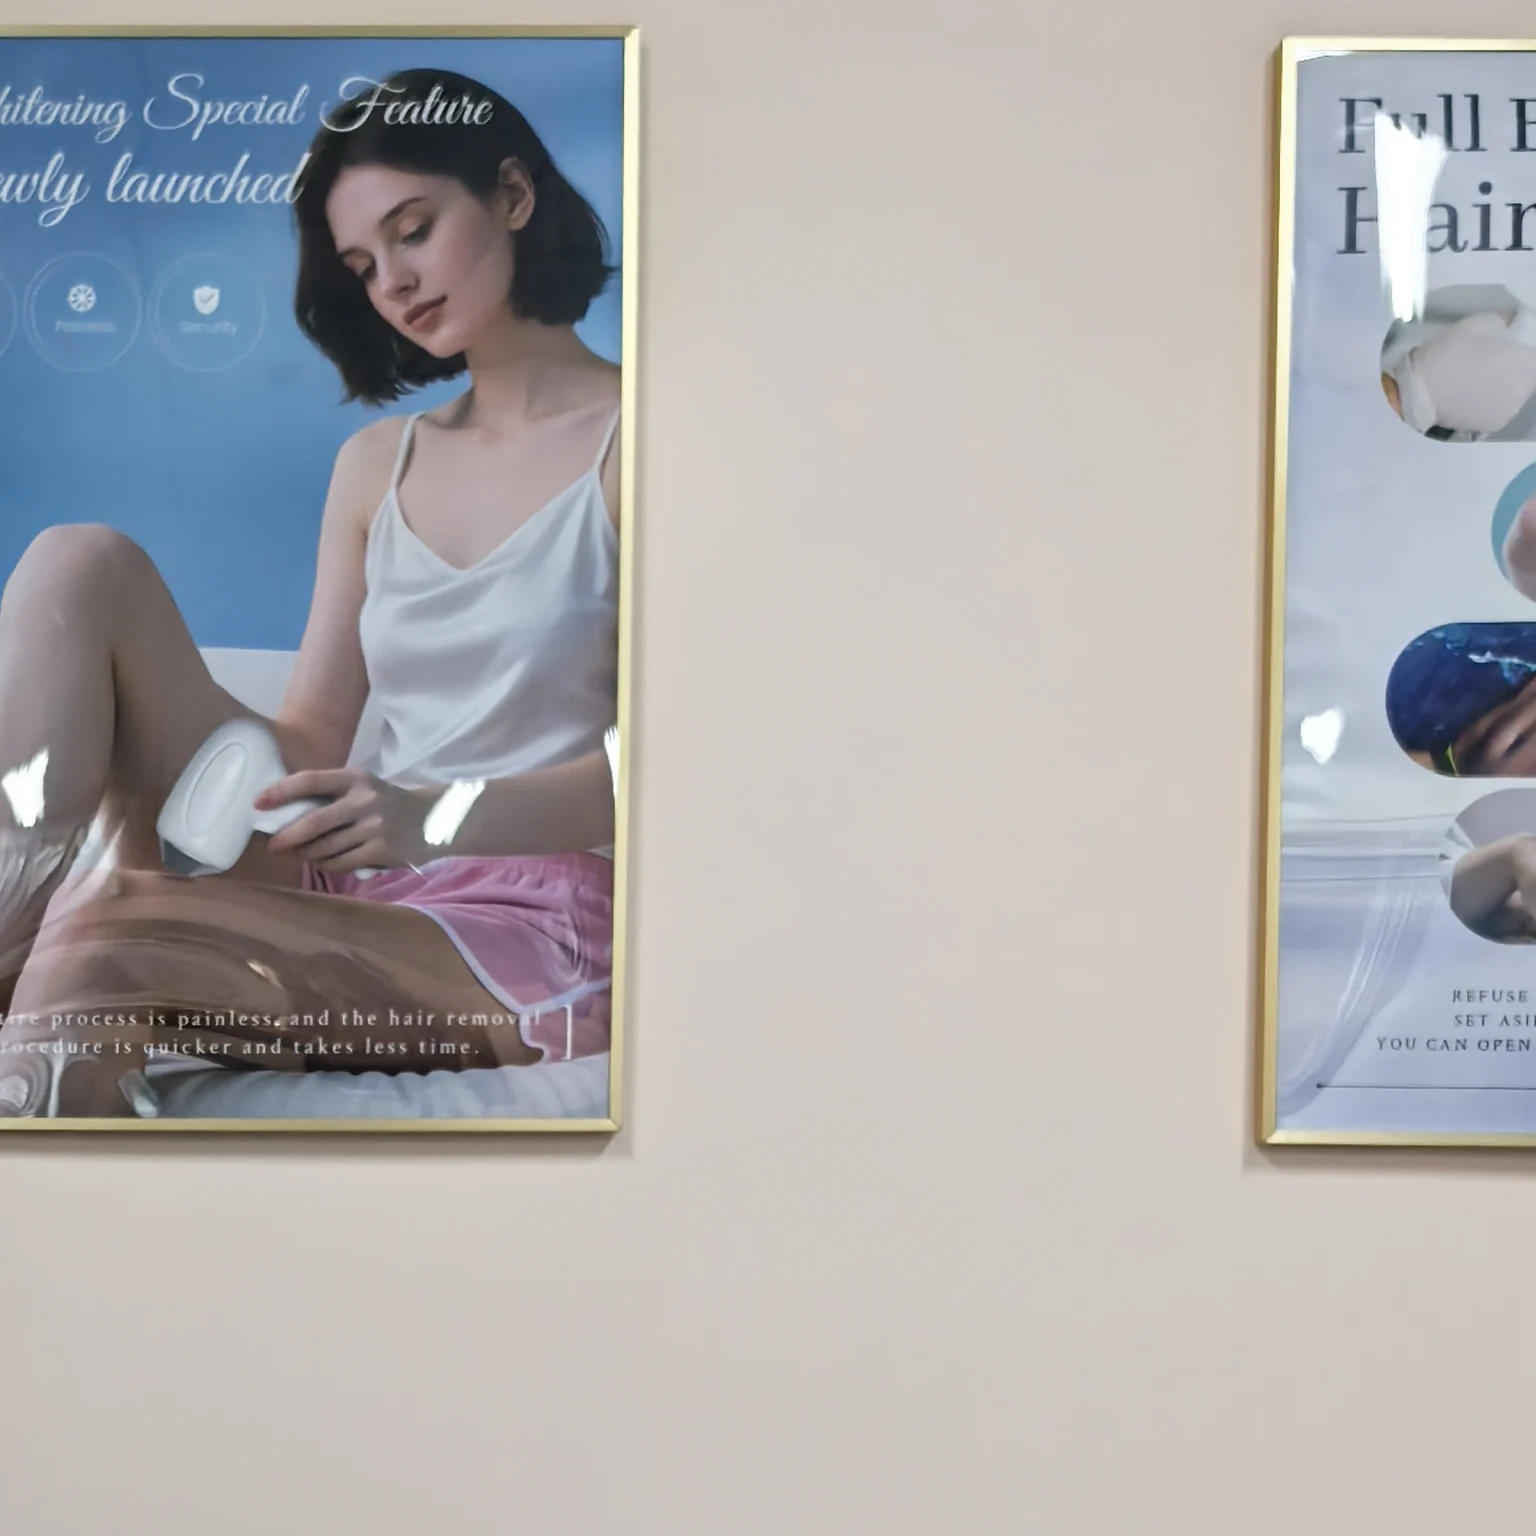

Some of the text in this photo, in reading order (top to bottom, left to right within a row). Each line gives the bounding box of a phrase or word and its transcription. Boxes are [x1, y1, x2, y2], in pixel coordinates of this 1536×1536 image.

[143, 72, 311, 141] Special
[319, 76, 495, 133] Feature
[105, 149, 314, 205] launched
[1452, 988, 1529, 1004] REFUSE
[51, 1013, 137, 1030] process
[149, 1009, 166, 1026] is
[289, 1009, 330, 1026] and
[341, 1009, 377, 1026] the
[388, 1009, 436, 1026] hair
[446, 1009, 541, 1027] removal
[1454, 1014, 1490, 1028] SET
[114, 1038, 132, 1055] is
[143, 1037, 231, 1058] quicker
[242, 1037, 282, 1055] and
[293, 1037, 354, 1055] takes
[365, 1037, 408, 1055] less
[418, 1038, 480, 1055] time.
[1376, 1037, 1531, 1052] YOU CAN OPEN
